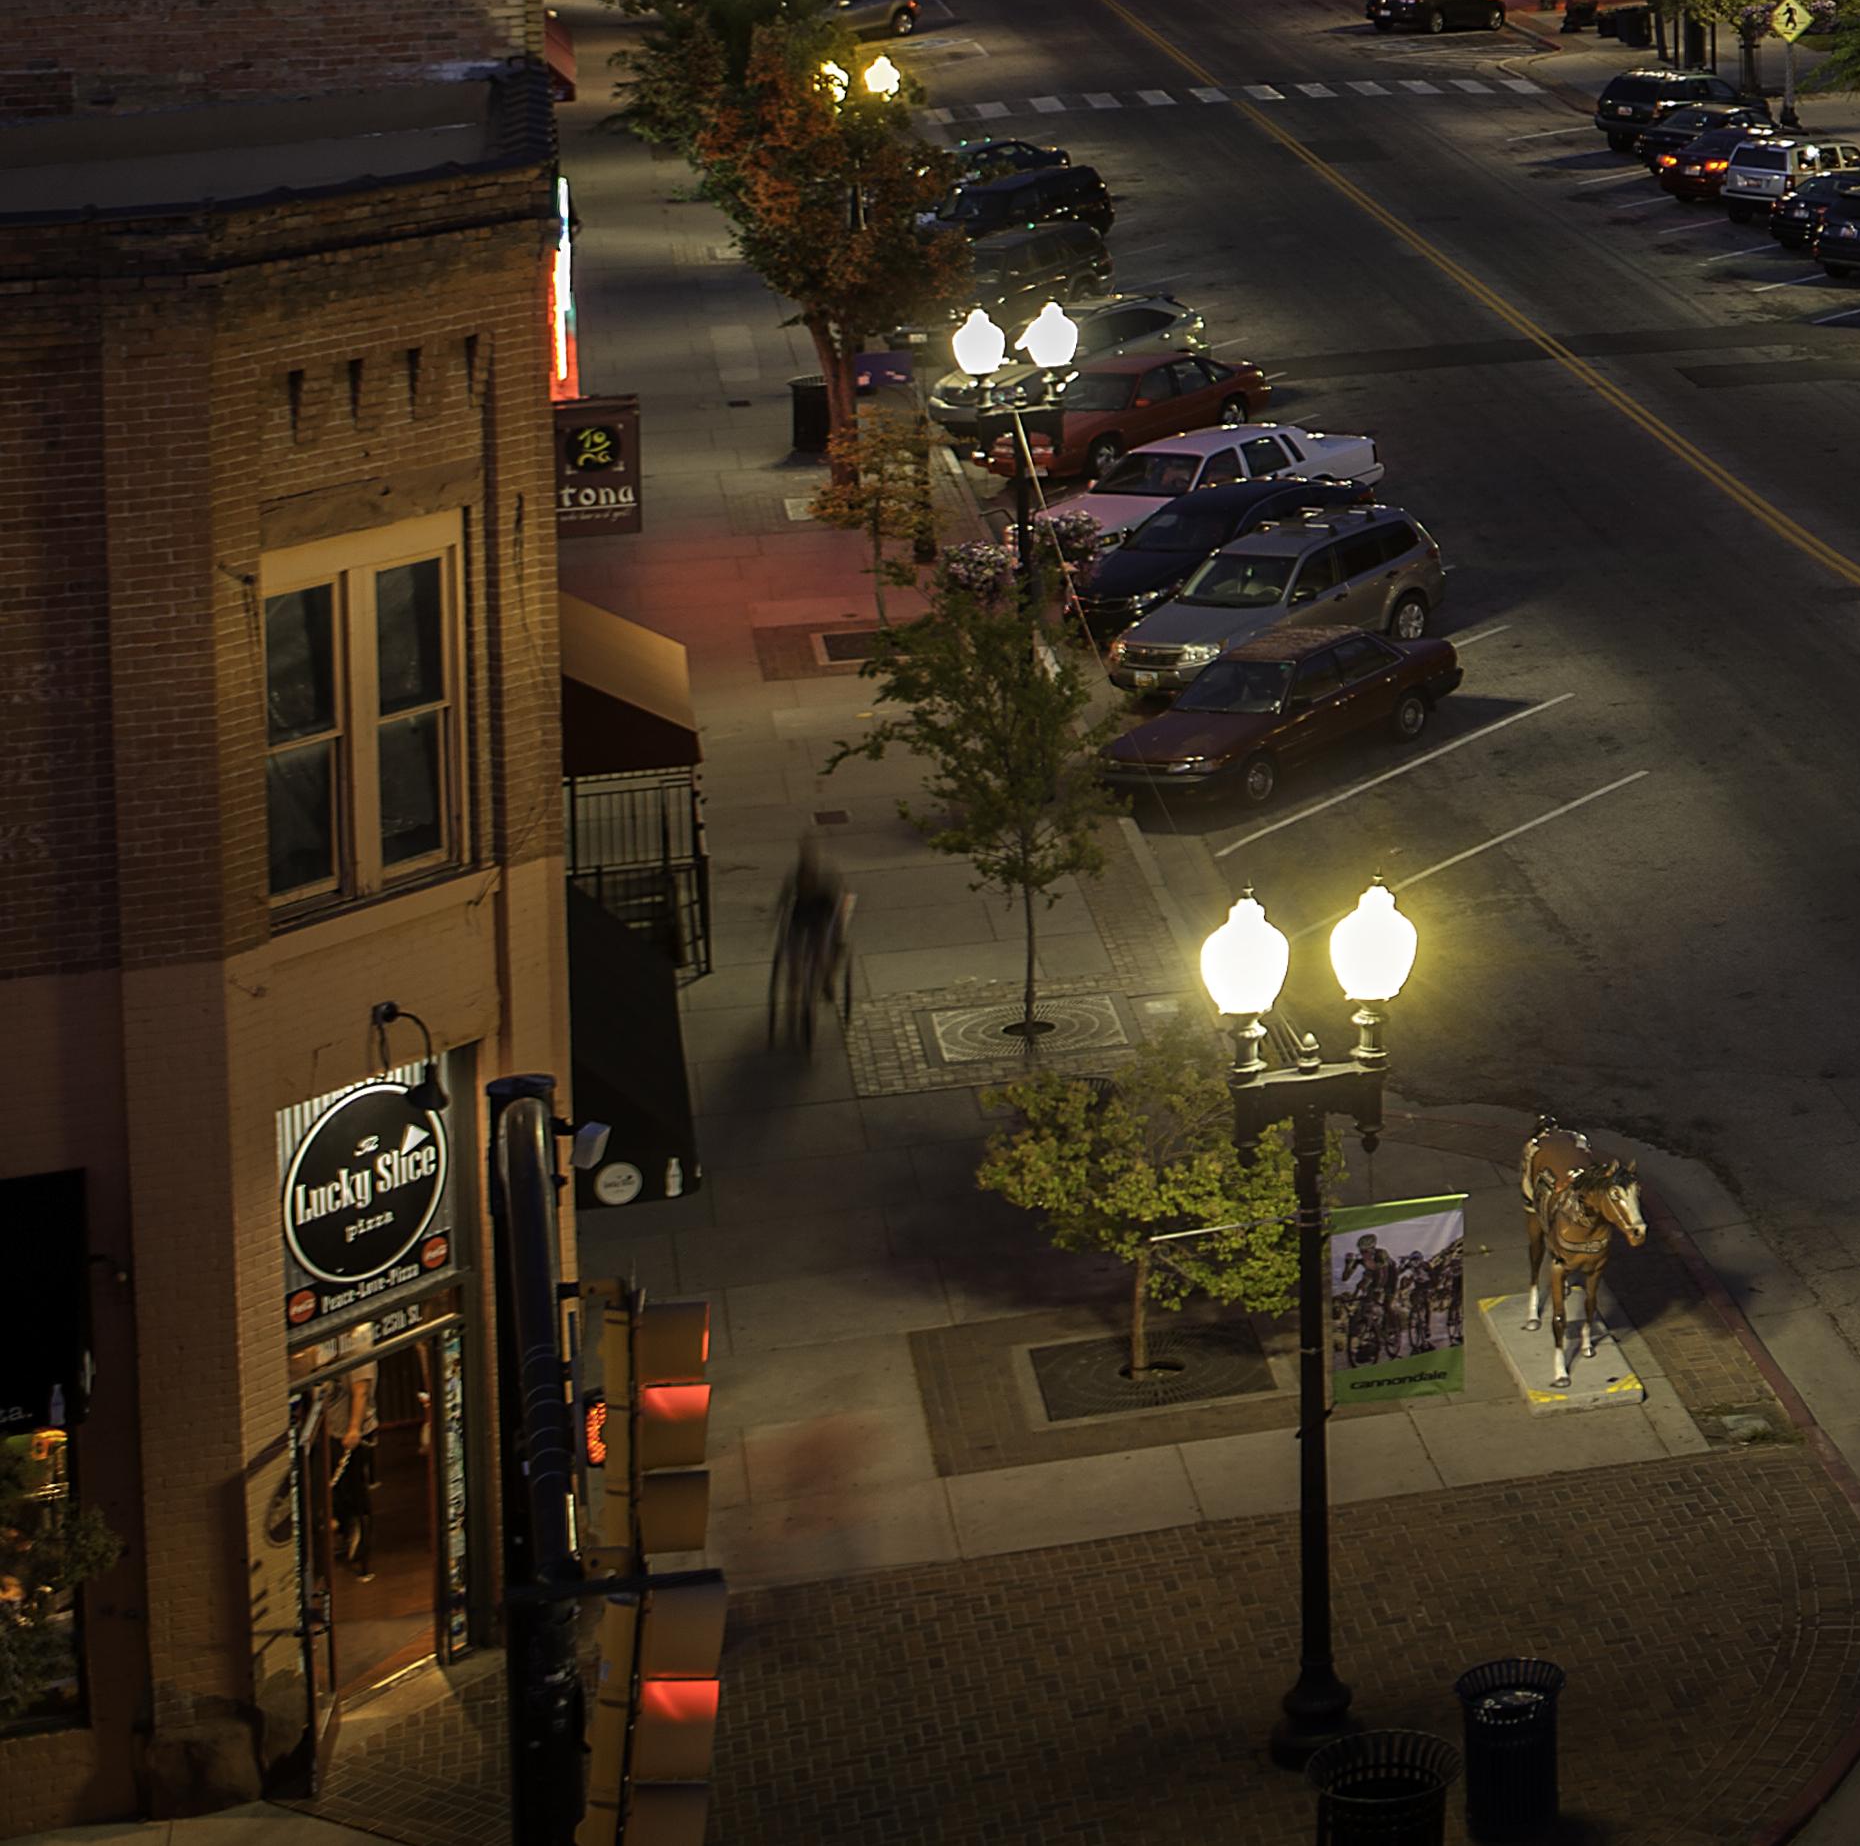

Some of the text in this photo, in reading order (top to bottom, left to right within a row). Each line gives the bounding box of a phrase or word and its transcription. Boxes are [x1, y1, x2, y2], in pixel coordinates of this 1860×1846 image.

[559, 485, 635, 508] tona
[295, 1143, 438, 1227] Lucky Slice
[344, 1209, 396, 1244] pizza
[1350, 1370, 1448, 1390] cannondale
